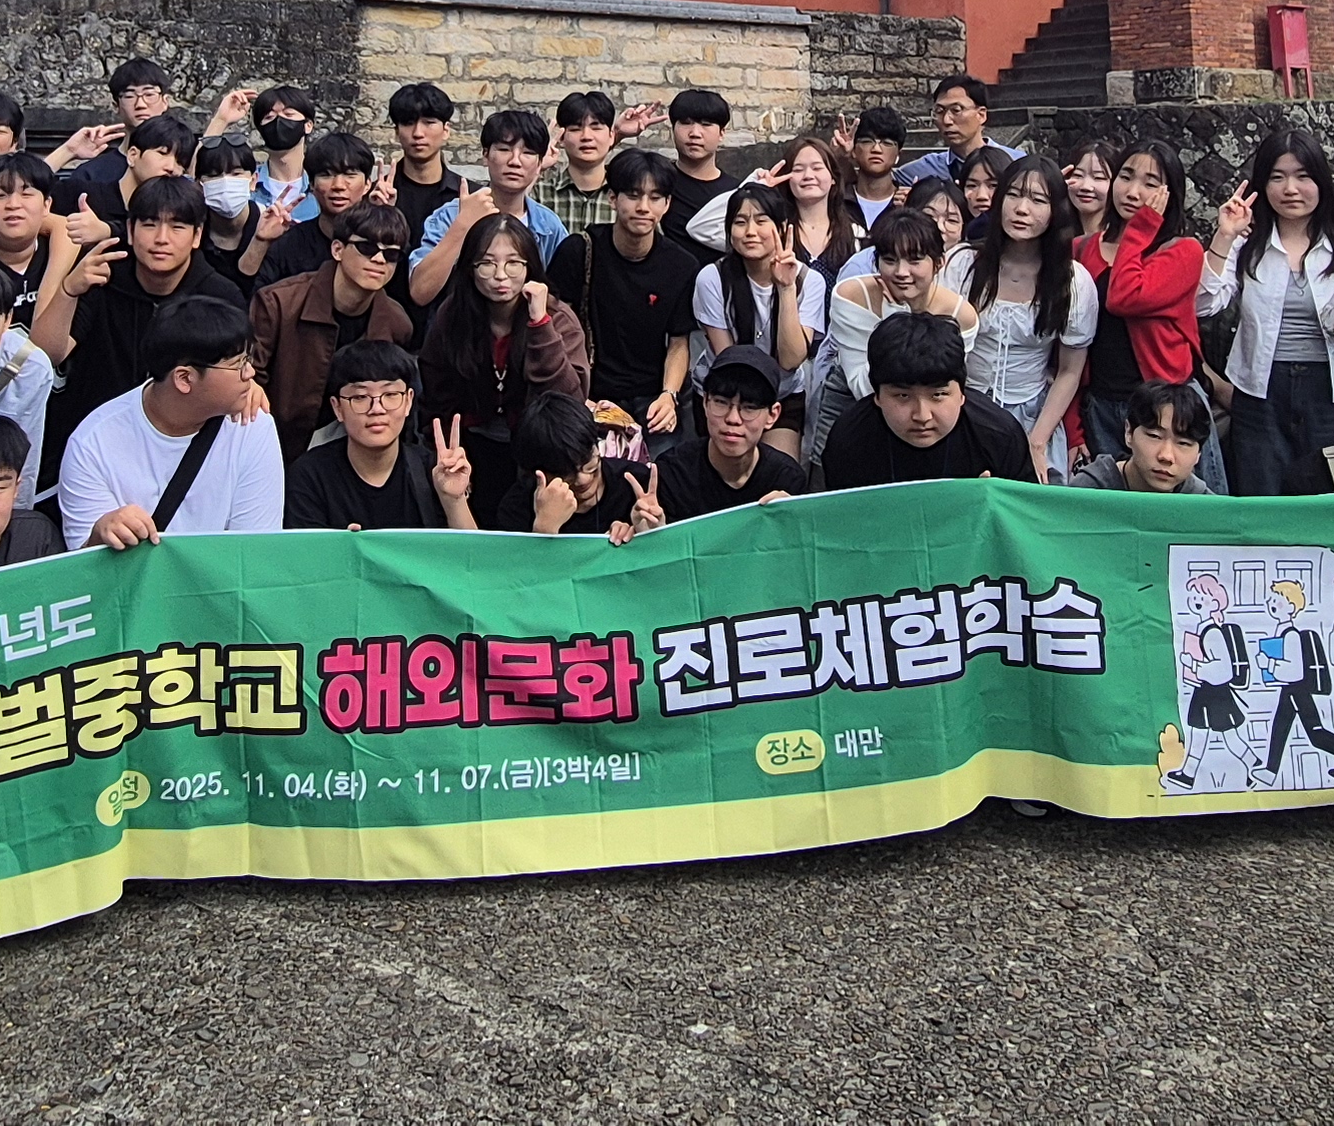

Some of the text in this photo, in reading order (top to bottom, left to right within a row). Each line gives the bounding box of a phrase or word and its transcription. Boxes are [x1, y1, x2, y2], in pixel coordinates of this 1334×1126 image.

[322, 635, 640, 730] 해외문화
[656, 579, 1102, 714] 진로체험학습
[766, 736, 816, 765] 장소
[834, 726, 883, 758] 대만
[160, 771, 230, 801] 2025.
[242, 771, 275, 798] 11.
[284, 768, 367, 802] 04.(화)
[414, 768, 451, 794] 11.
